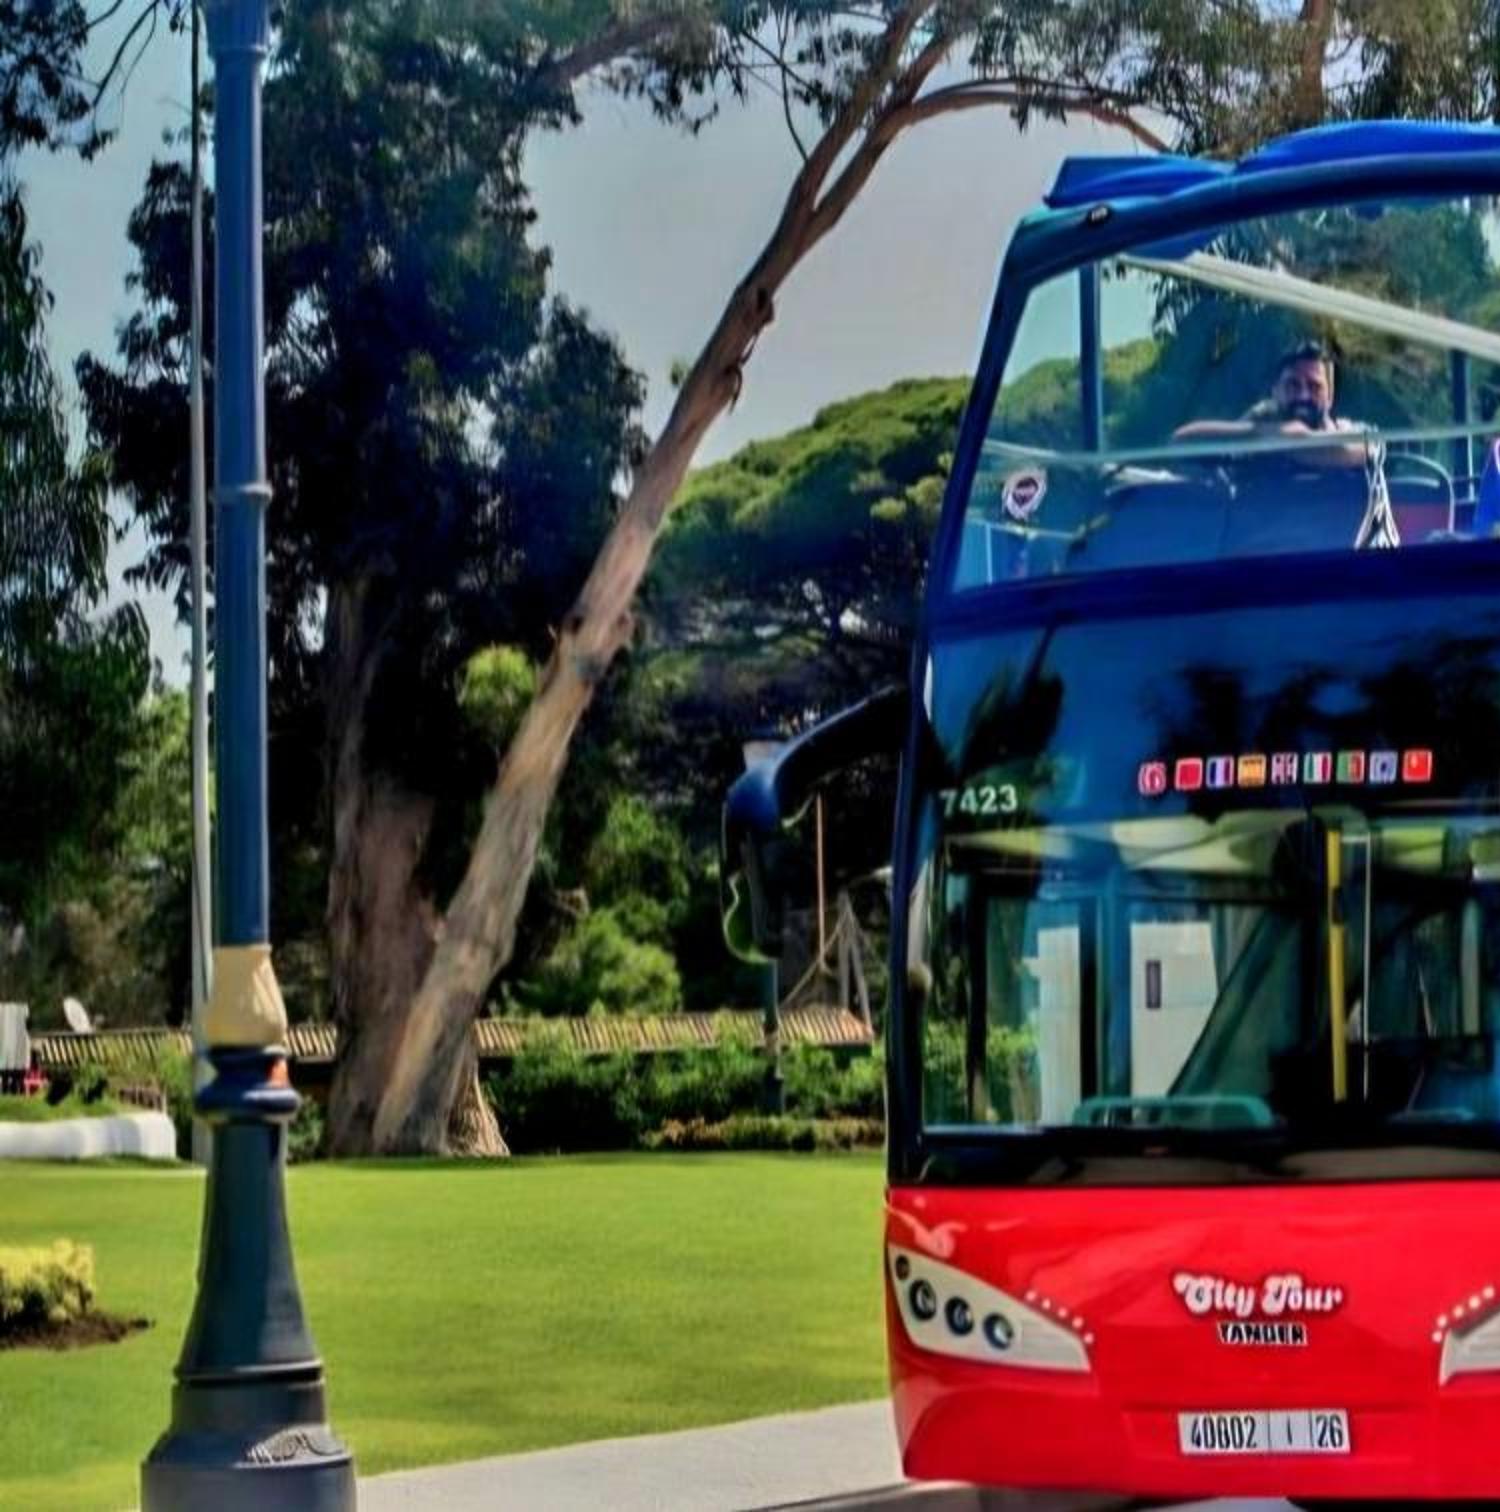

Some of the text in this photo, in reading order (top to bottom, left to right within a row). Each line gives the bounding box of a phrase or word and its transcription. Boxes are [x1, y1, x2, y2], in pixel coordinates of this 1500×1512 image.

[940, 784, 1018, 819] 7423
[1173, 1272, 1343, 1317] City Tour
[1316, 1414, 1344, 1449] 26
